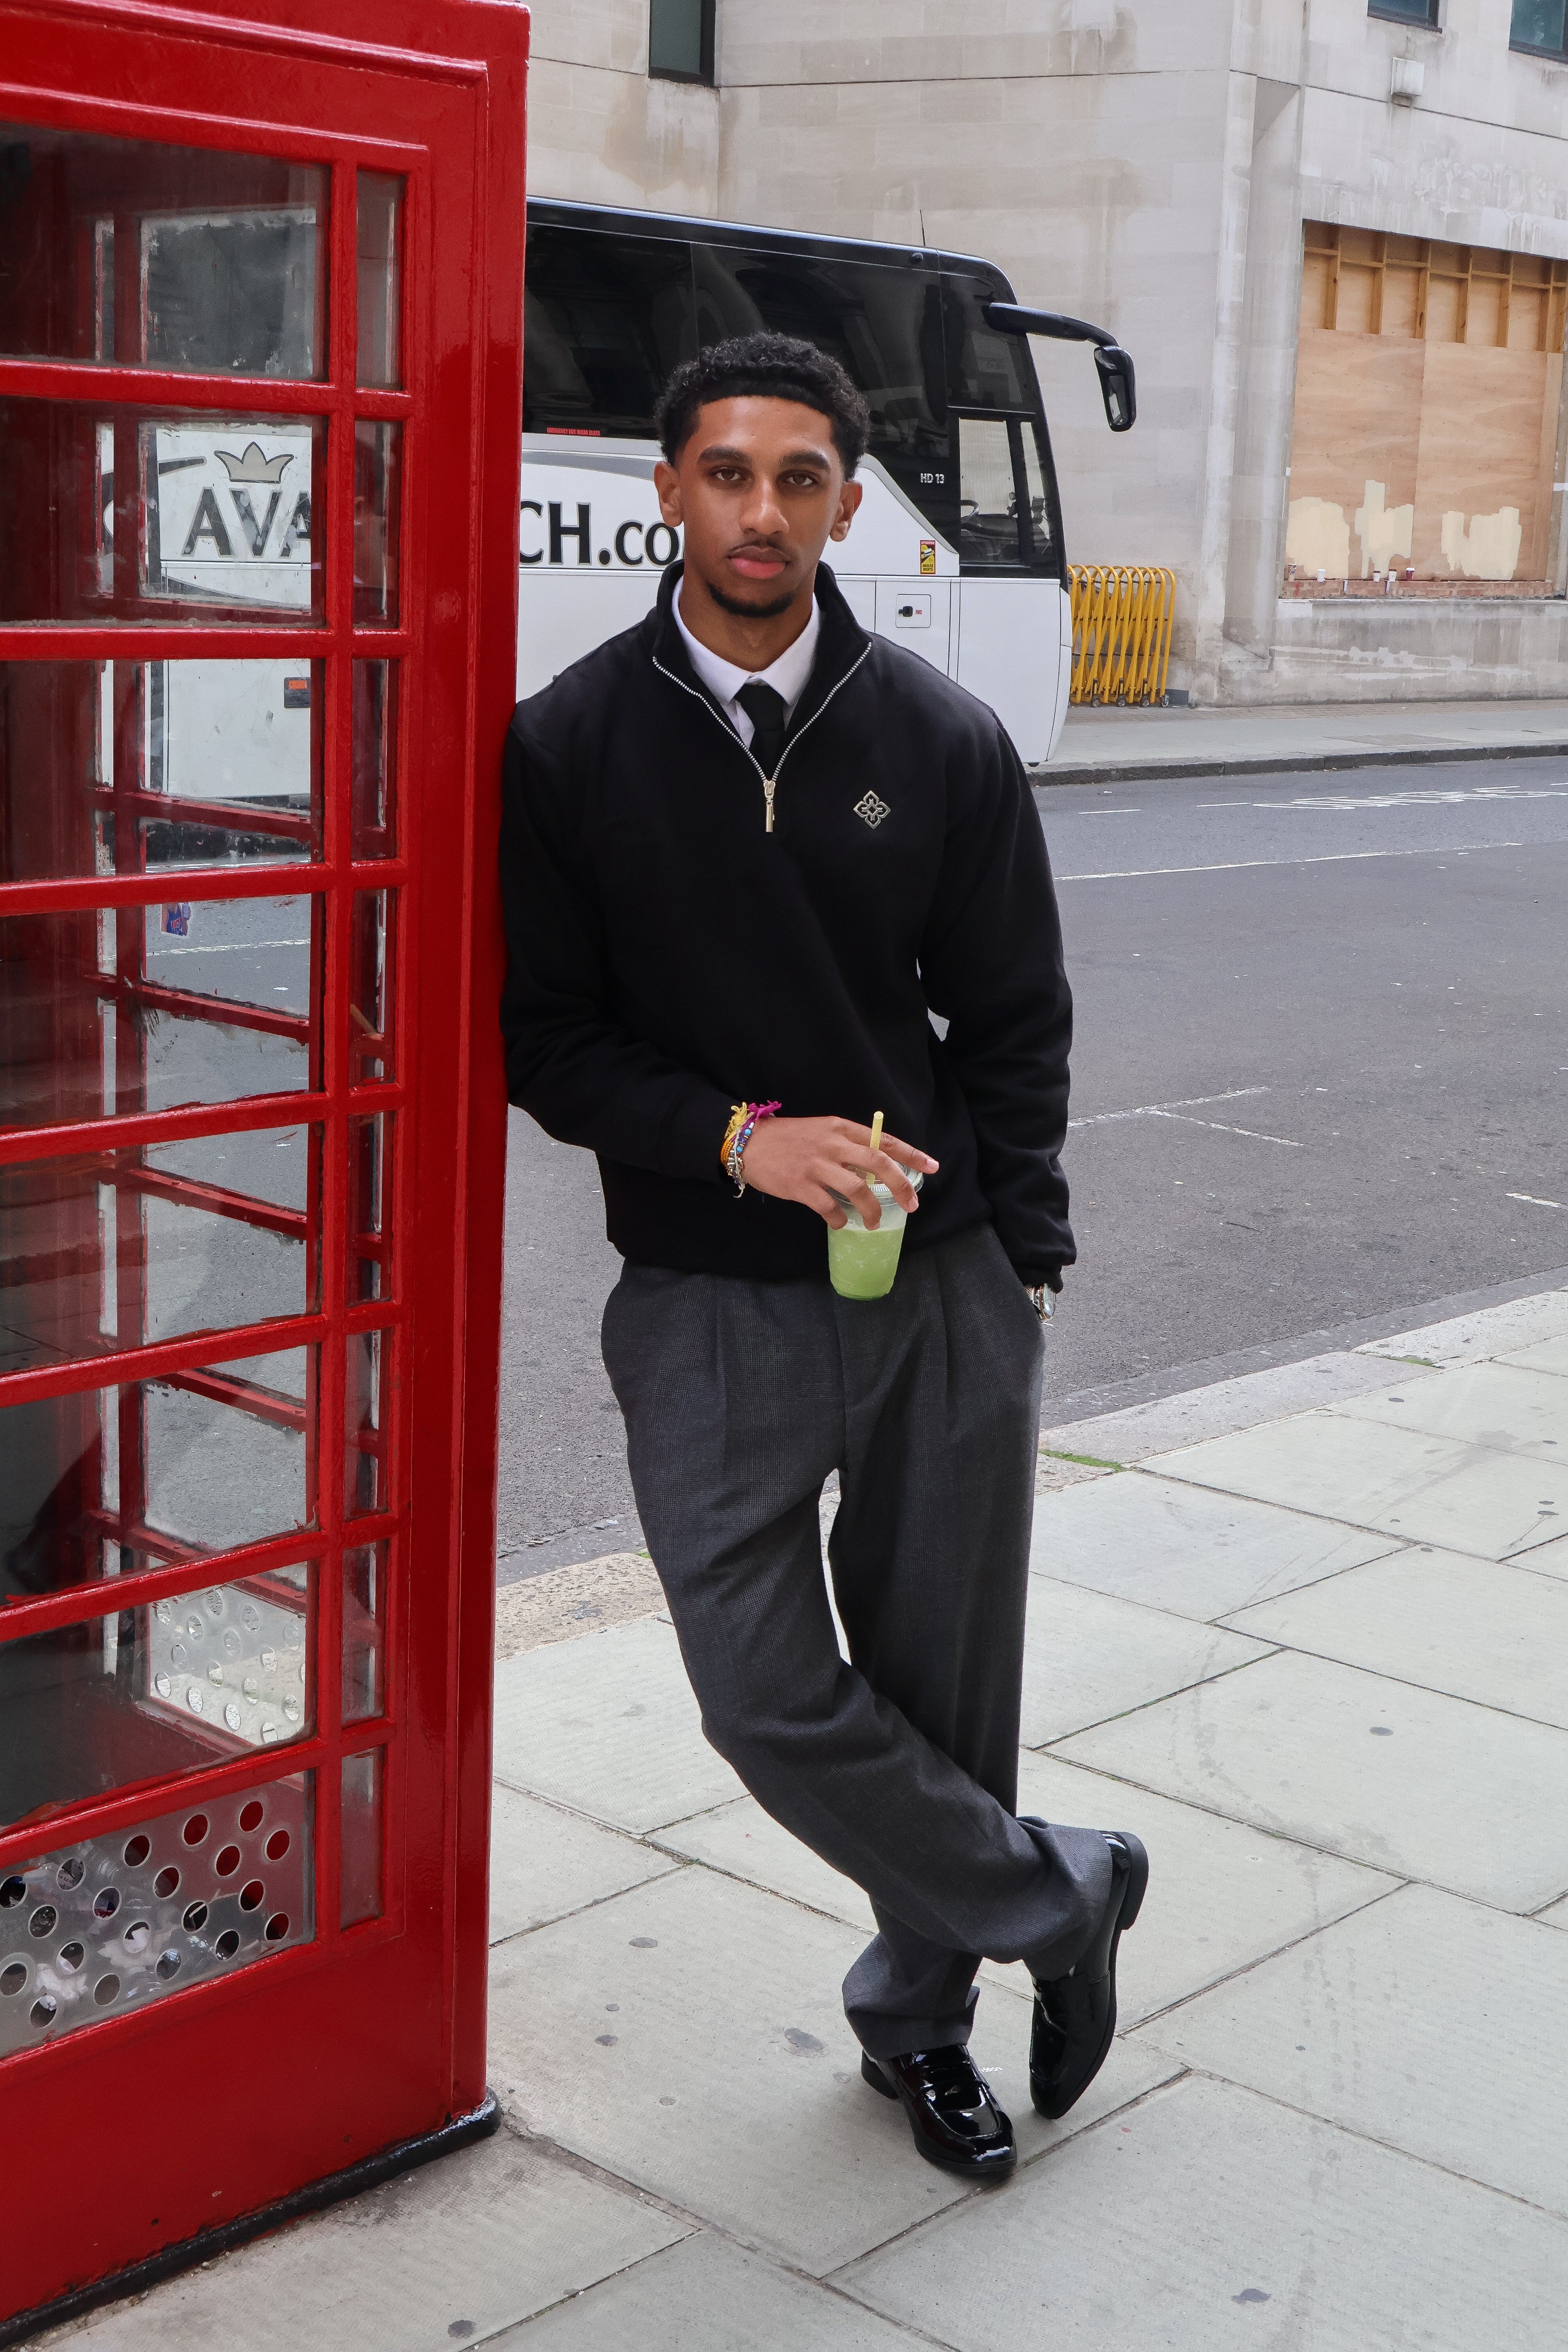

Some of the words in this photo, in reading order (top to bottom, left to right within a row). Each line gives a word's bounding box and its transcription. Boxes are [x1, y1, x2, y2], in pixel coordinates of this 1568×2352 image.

[920, 473, 933, 483] HD
[935, 474, 944, 484] 13
[181, 486, 311, 558] AVA
[520, 499, 684, 567] CH.co
[1252, 790, 1568, 810] COACHES
